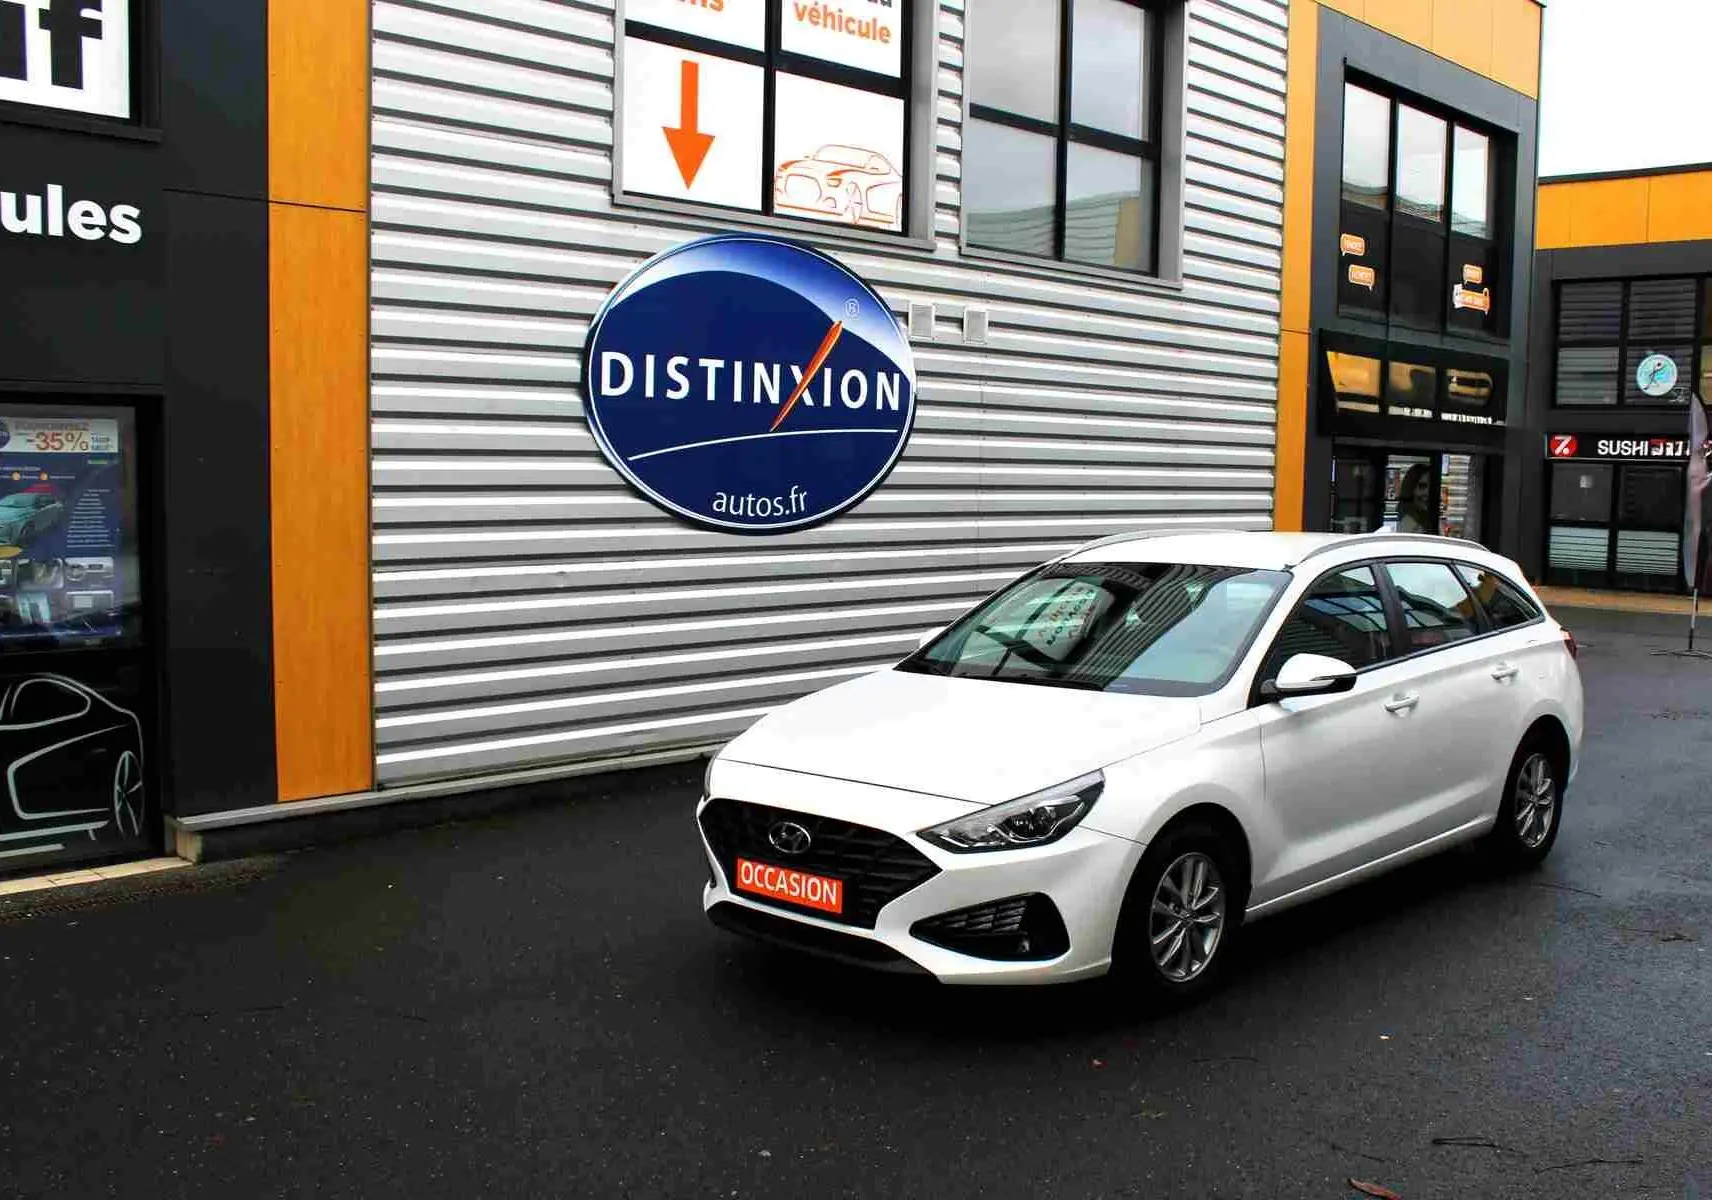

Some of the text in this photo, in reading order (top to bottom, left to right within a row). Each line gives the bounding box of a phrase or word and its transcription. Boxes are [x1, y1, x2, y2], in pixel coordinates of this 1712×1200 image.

[793, 1, 891, 43] véhicule
[0, 183, 142, 244] ules
[599, 349, 899, 412] DISTINXION
[1597, 440, 1649, 456] SUSHI
[712, 485, 807, 517] autos.fr
[741, 861, 837, 906] OCCASION
